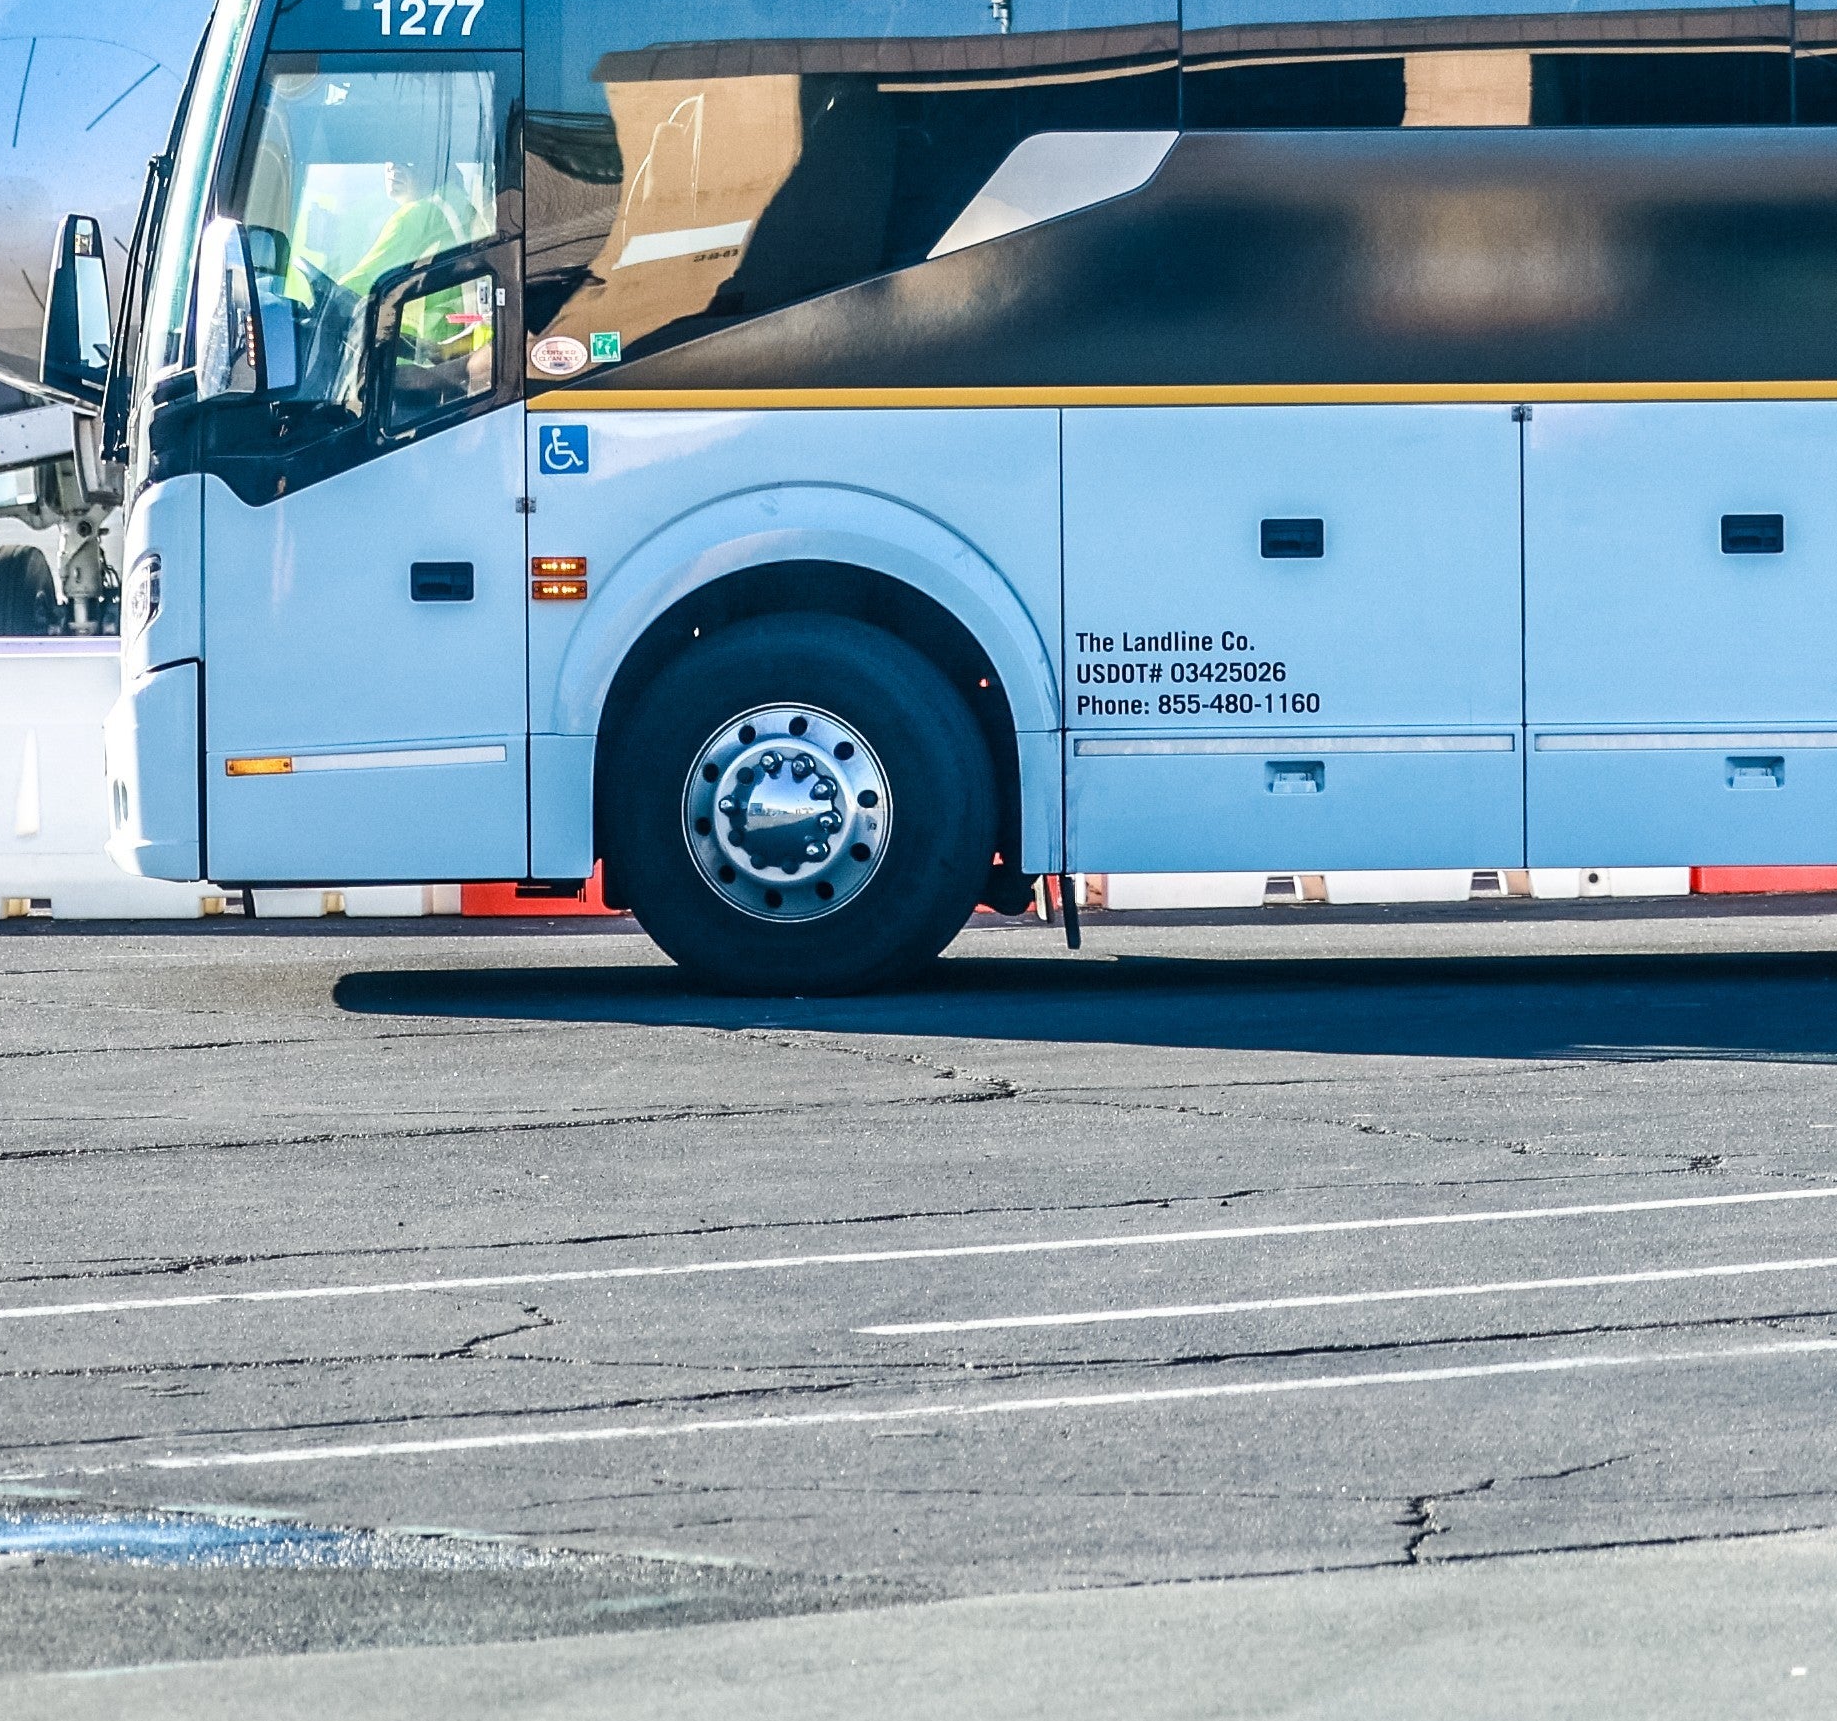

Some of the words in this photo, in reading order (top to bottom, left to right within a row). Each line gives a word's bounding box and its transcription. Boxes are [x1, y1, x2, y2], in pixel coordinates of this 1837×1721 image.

[1075, 632, 1114, 653] The
[1122, 630, 1213, 652] Landline
[1221, 630, 1256, 652] Co.
[1077, 663, 1163, 684] USDOT#
[1170, 662, 1287, 683] 03425026
[1077, 695, 1150, 716] Phone:
[1158, 693, 1321, 715] 855-480-1160
